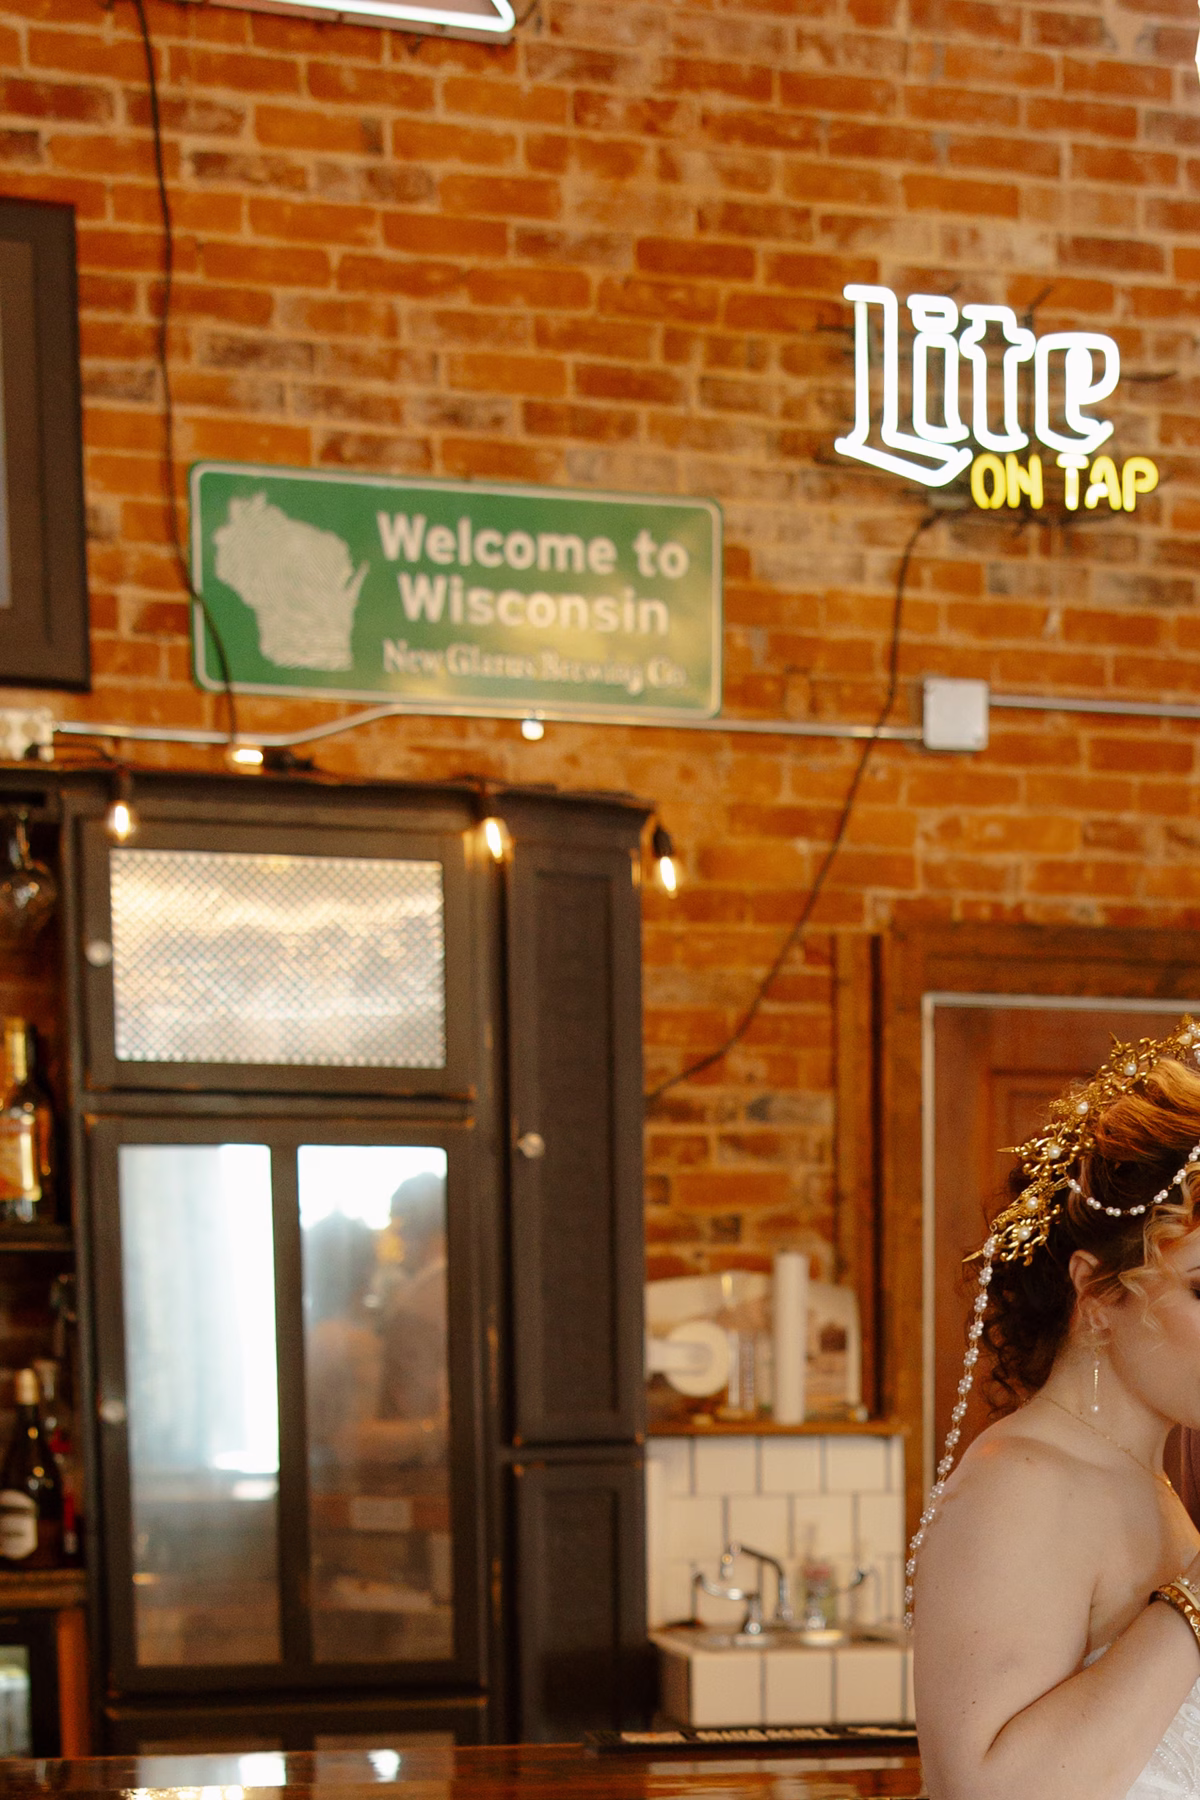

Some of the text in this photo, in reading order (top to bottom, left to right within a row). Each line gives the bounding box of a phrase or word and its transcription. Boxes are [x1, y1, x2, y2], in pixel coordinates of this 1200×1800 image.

[834, 284, 1121, 487] Lite
[970, 452, 1159, 512] ON TAP
[376, 511, 689, 580] Welcome to
[397, 572, 670, 636] Wisconsin
[382, 638, 443, 675] New
